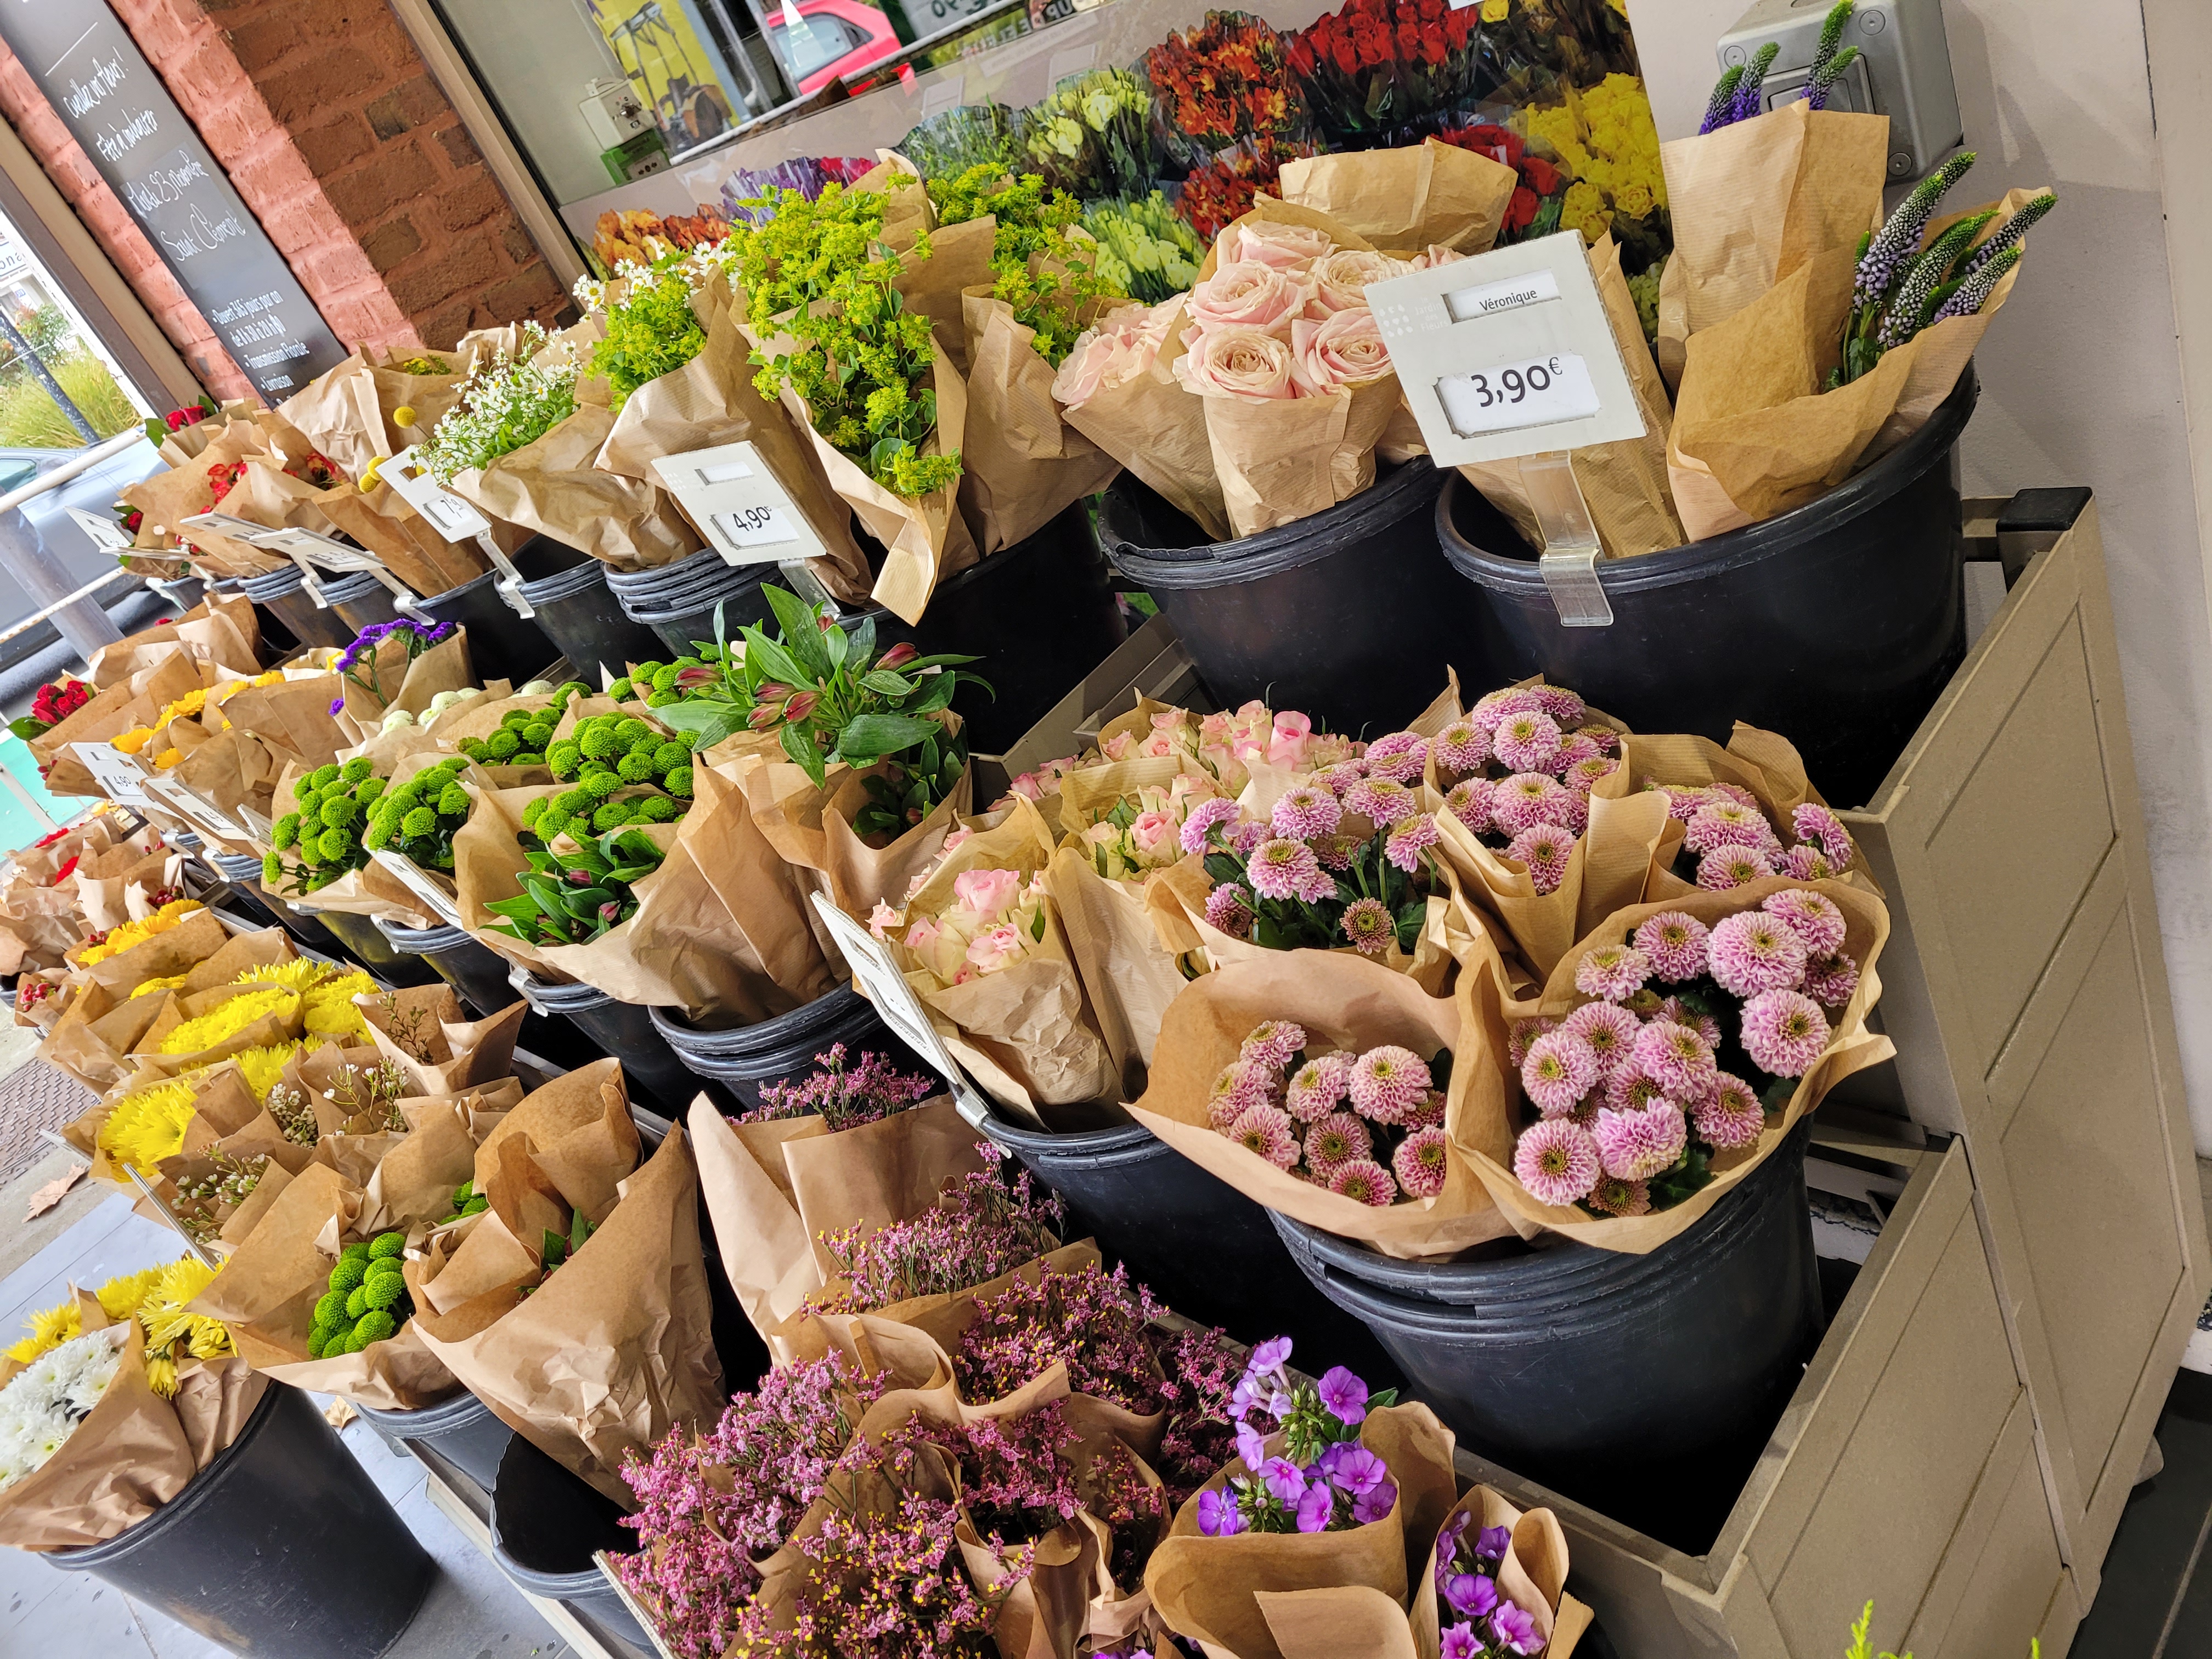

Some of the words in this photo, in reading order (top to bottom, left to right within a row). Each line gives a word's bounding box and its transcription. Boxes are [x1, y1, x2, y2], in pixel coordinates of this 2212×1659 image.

[149, 171, 179, 202] 23
[212, 305, 239, 325] Ouvert
[229, 300, 249, 318] 365
[241, 298, 264, 319] jours
[258, 294, 274, 313] par
[270, 290, 284, 304] an
[1480, 289, 1538, 312] Véronique
[244, 346, 289, 370] Transmission
[280, 338, 310, 359] Florale
[260, 373, 295, 392] Livraison
[1471, 357, 1563, 408] 3,90€
[114, 776, 131, 787] 4,90
